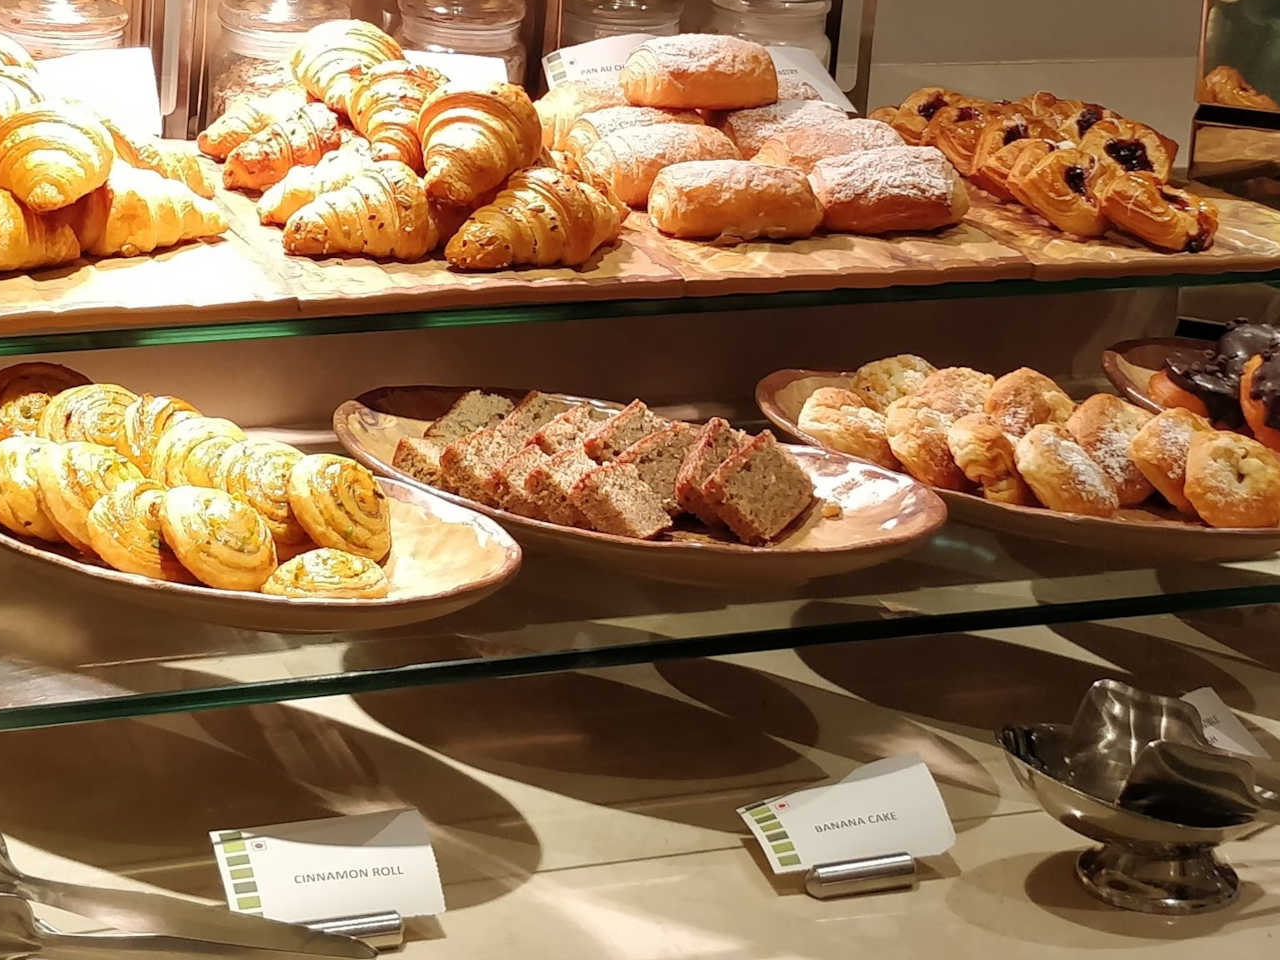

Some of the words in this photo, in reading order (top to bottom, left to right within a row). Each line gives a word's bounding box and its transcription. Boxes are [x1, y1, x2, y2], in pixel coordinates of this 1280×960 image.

[580, 67, 599, 76] PAN
[600, 64, 613, 73] AU
[814, 817, 865, 834] BANANA
[867, 810, 898, 827] CAKE
[293, 868, 369, 884] CINNAMON
[372, 865, 405, 877] ROLL
